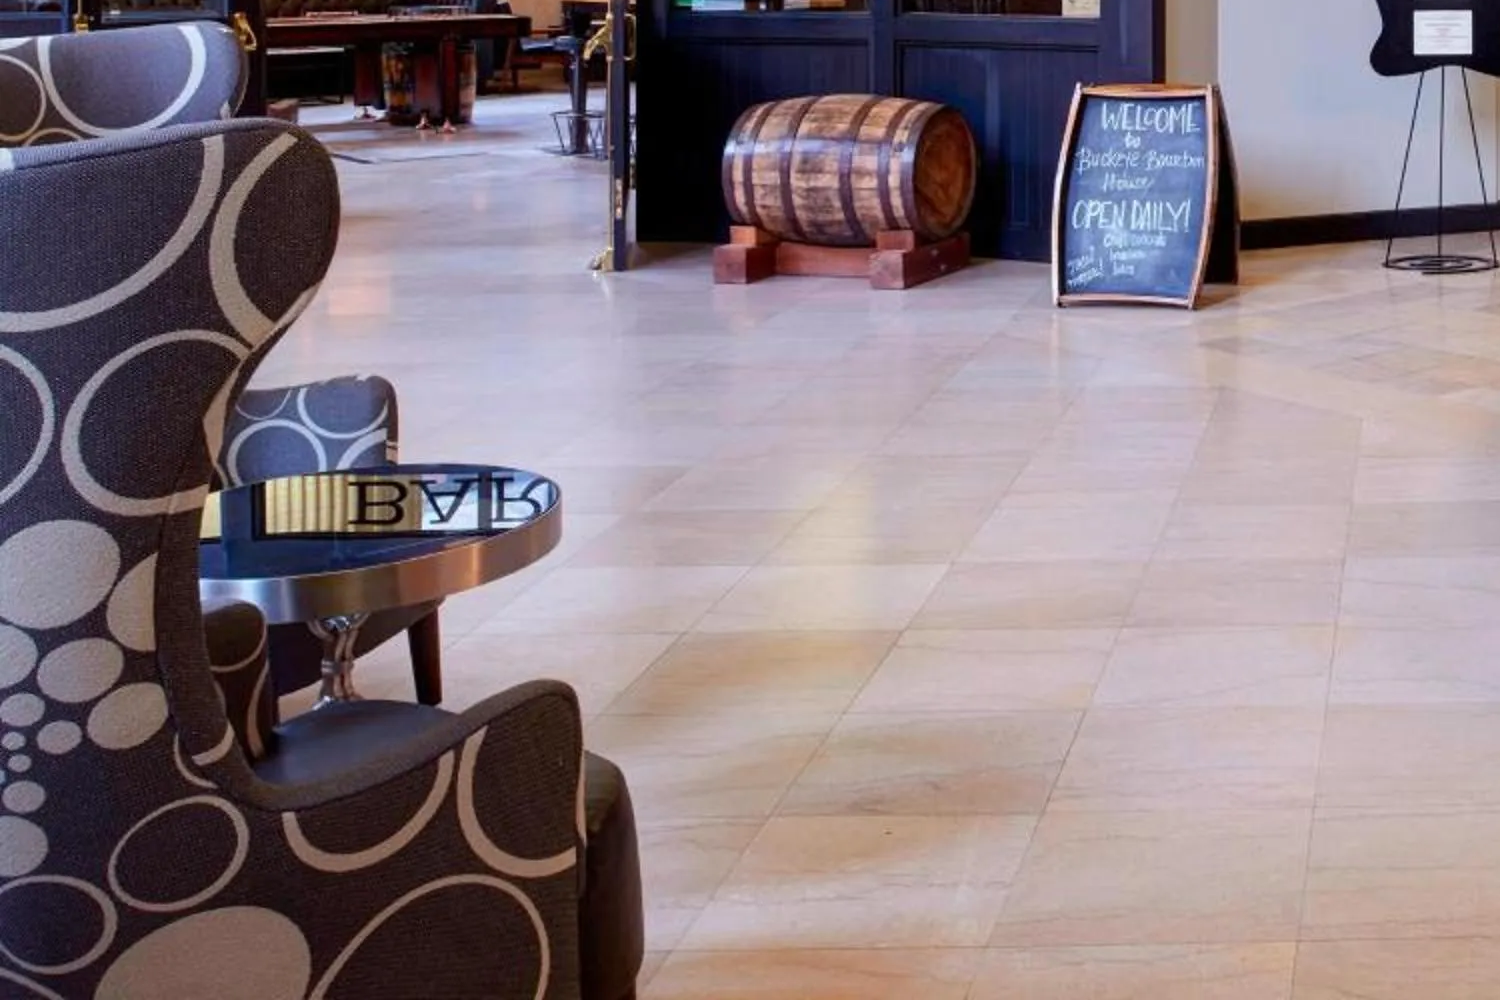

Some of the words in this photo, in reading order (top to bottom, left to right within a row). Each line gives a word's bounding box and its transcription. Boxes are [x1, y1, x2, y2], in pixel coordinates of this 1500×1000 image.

[1101, 101, 1201, 134] WELCOME
[1124, 131, 1141, 149] to
[1071, 199, 1125, 230] OPEN
[1130, 199, 1191, 233] DAILY!
